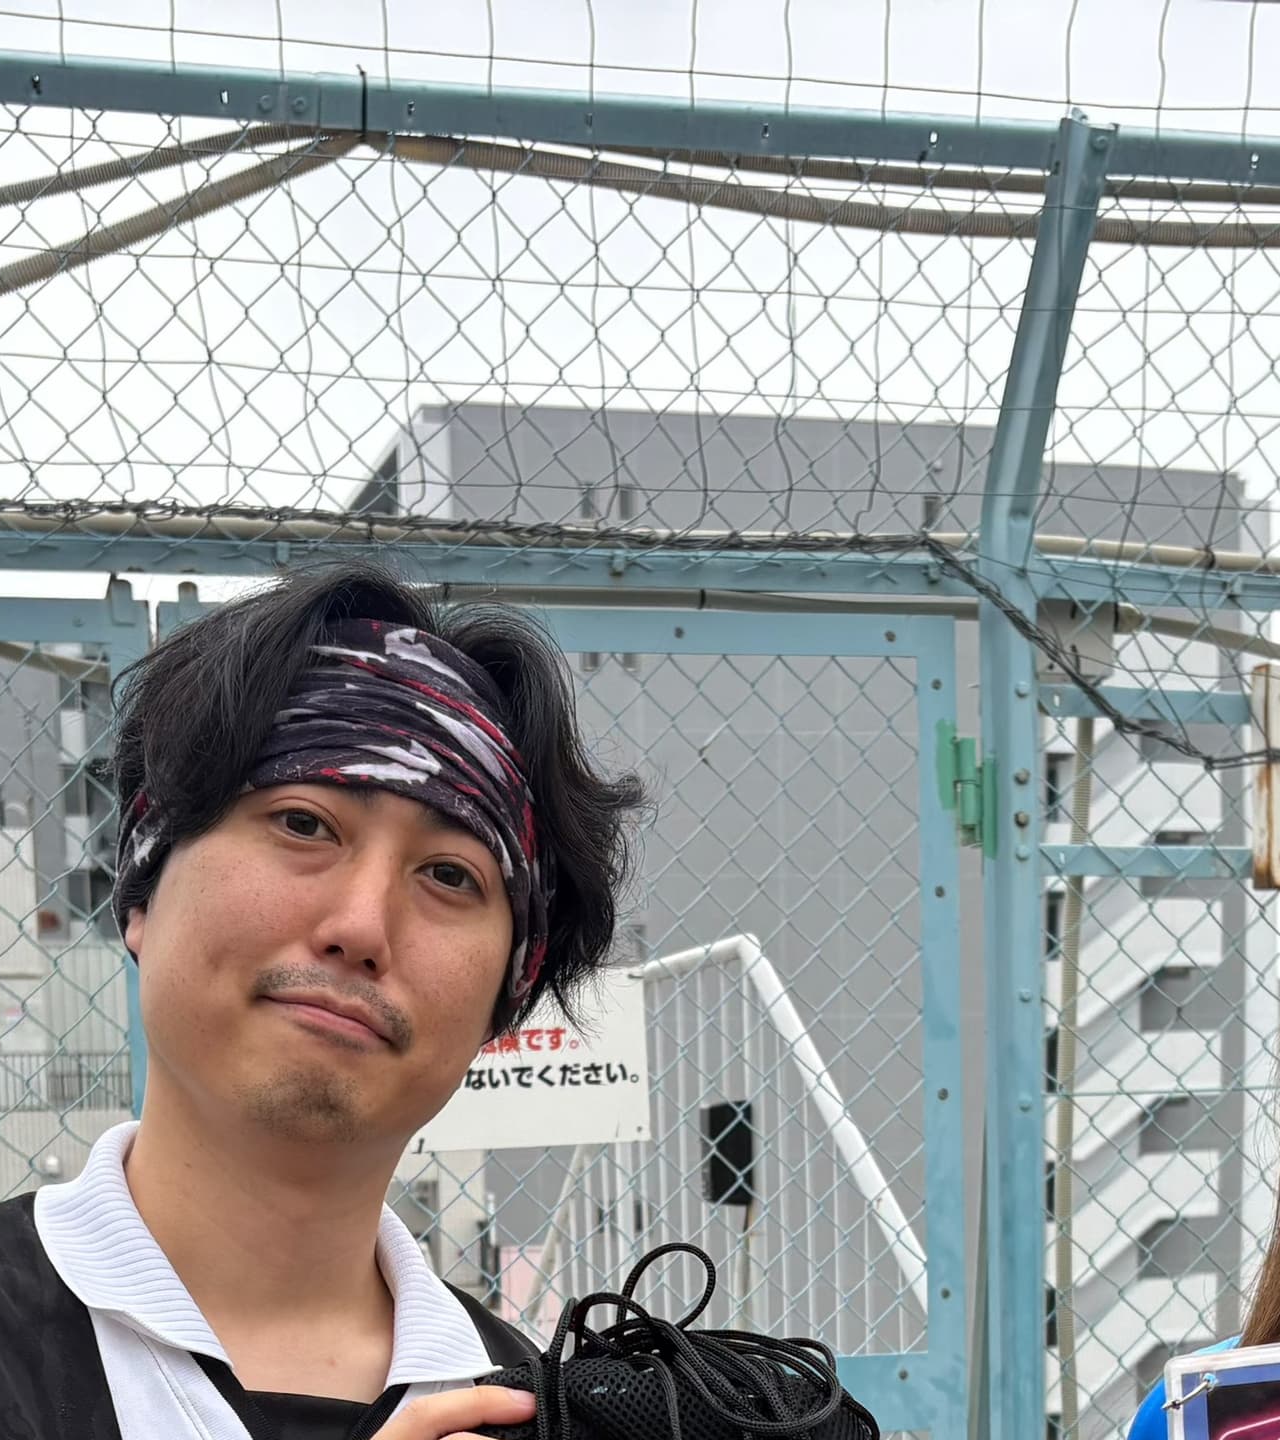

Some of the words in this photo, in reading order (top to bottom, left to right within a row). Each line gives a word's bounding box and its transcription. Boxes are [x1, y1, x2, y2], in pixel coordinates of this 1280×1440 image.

[465, 1062, 639, 1090] ないでください。
